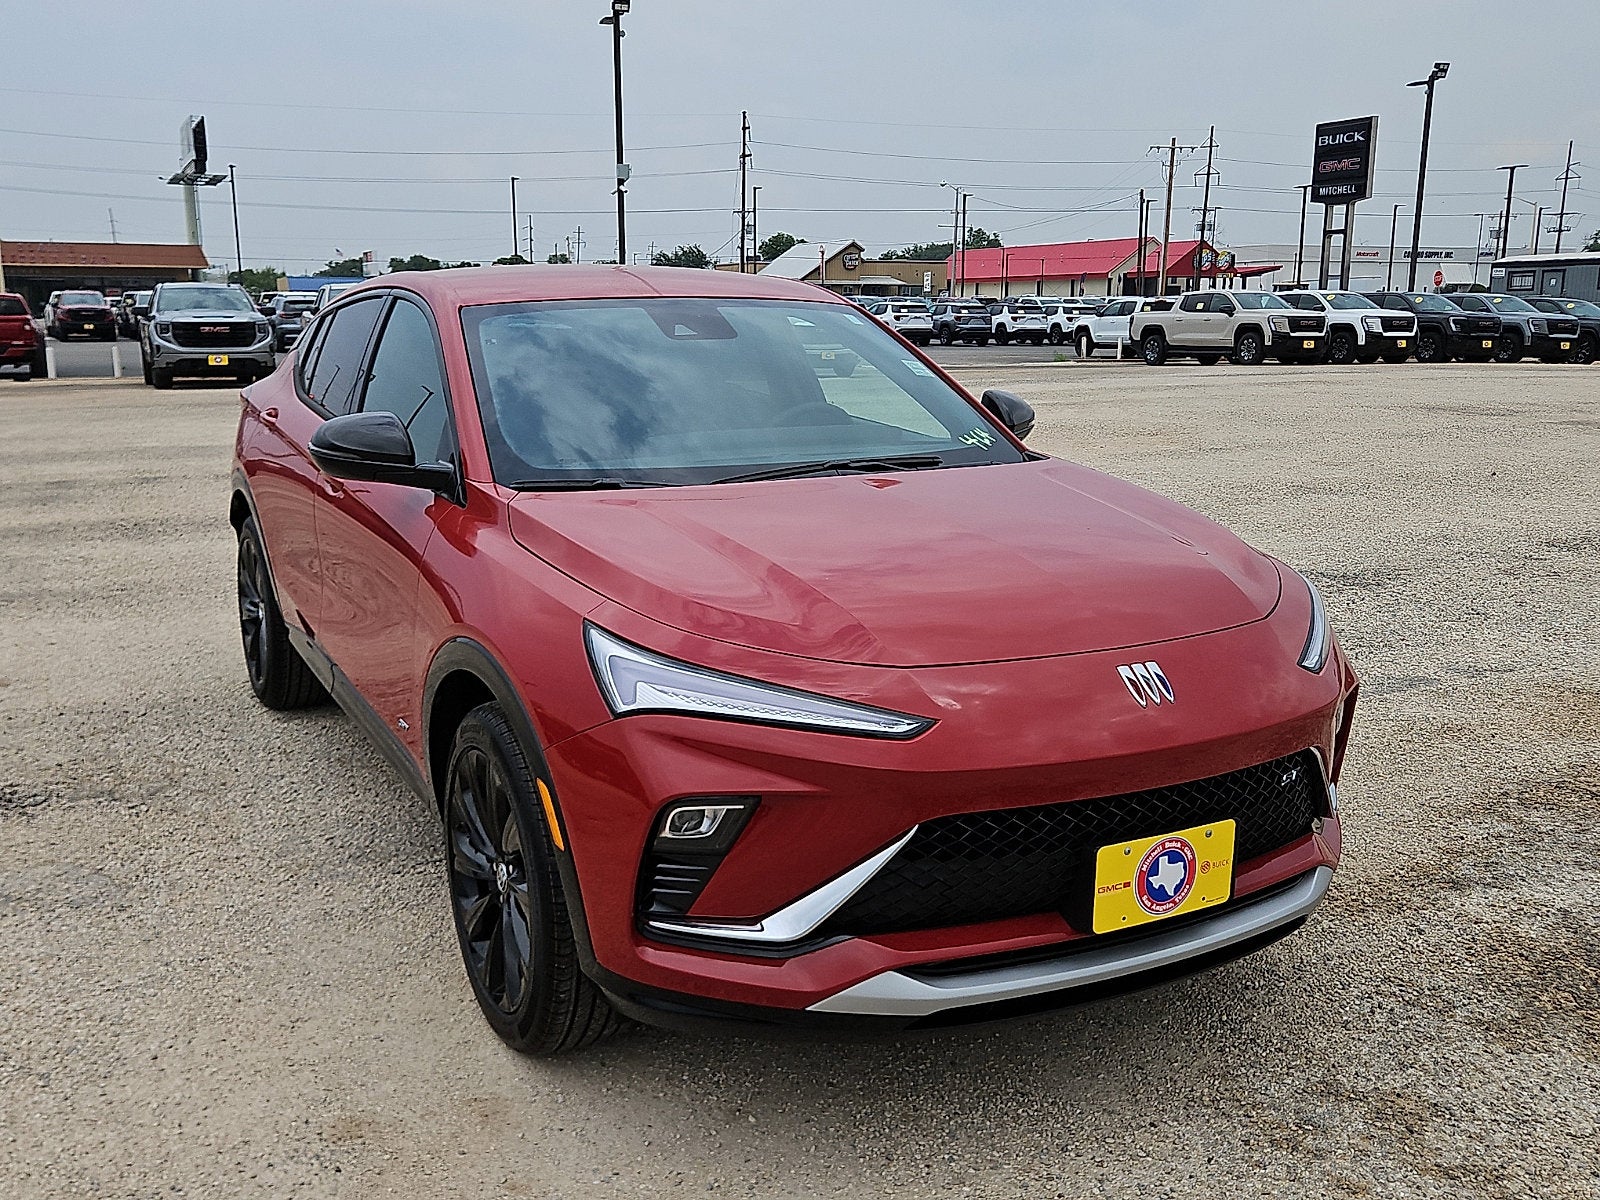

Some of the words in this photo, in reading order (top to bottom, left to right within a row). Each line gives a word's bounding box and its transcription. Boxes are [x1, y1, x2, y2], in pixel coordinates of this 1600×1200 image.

[1318, 130, 1366, 146] BUICK
[1318, 157, 1360, 173] GMC
[1319, 184, 1356, 196] MITCHELL
[1142, 846, 1163, 872] Mitchell
[1164, 840, 1182, 850] Buick
[1183, 846, 1193, 861] GMC
[1212, 858, 1230, 869] BUICK
[1098, 883, 1123, 894] GMC
[1141, 894, 1152, 908] San
[1174, 884, 1190, 903] Texas
